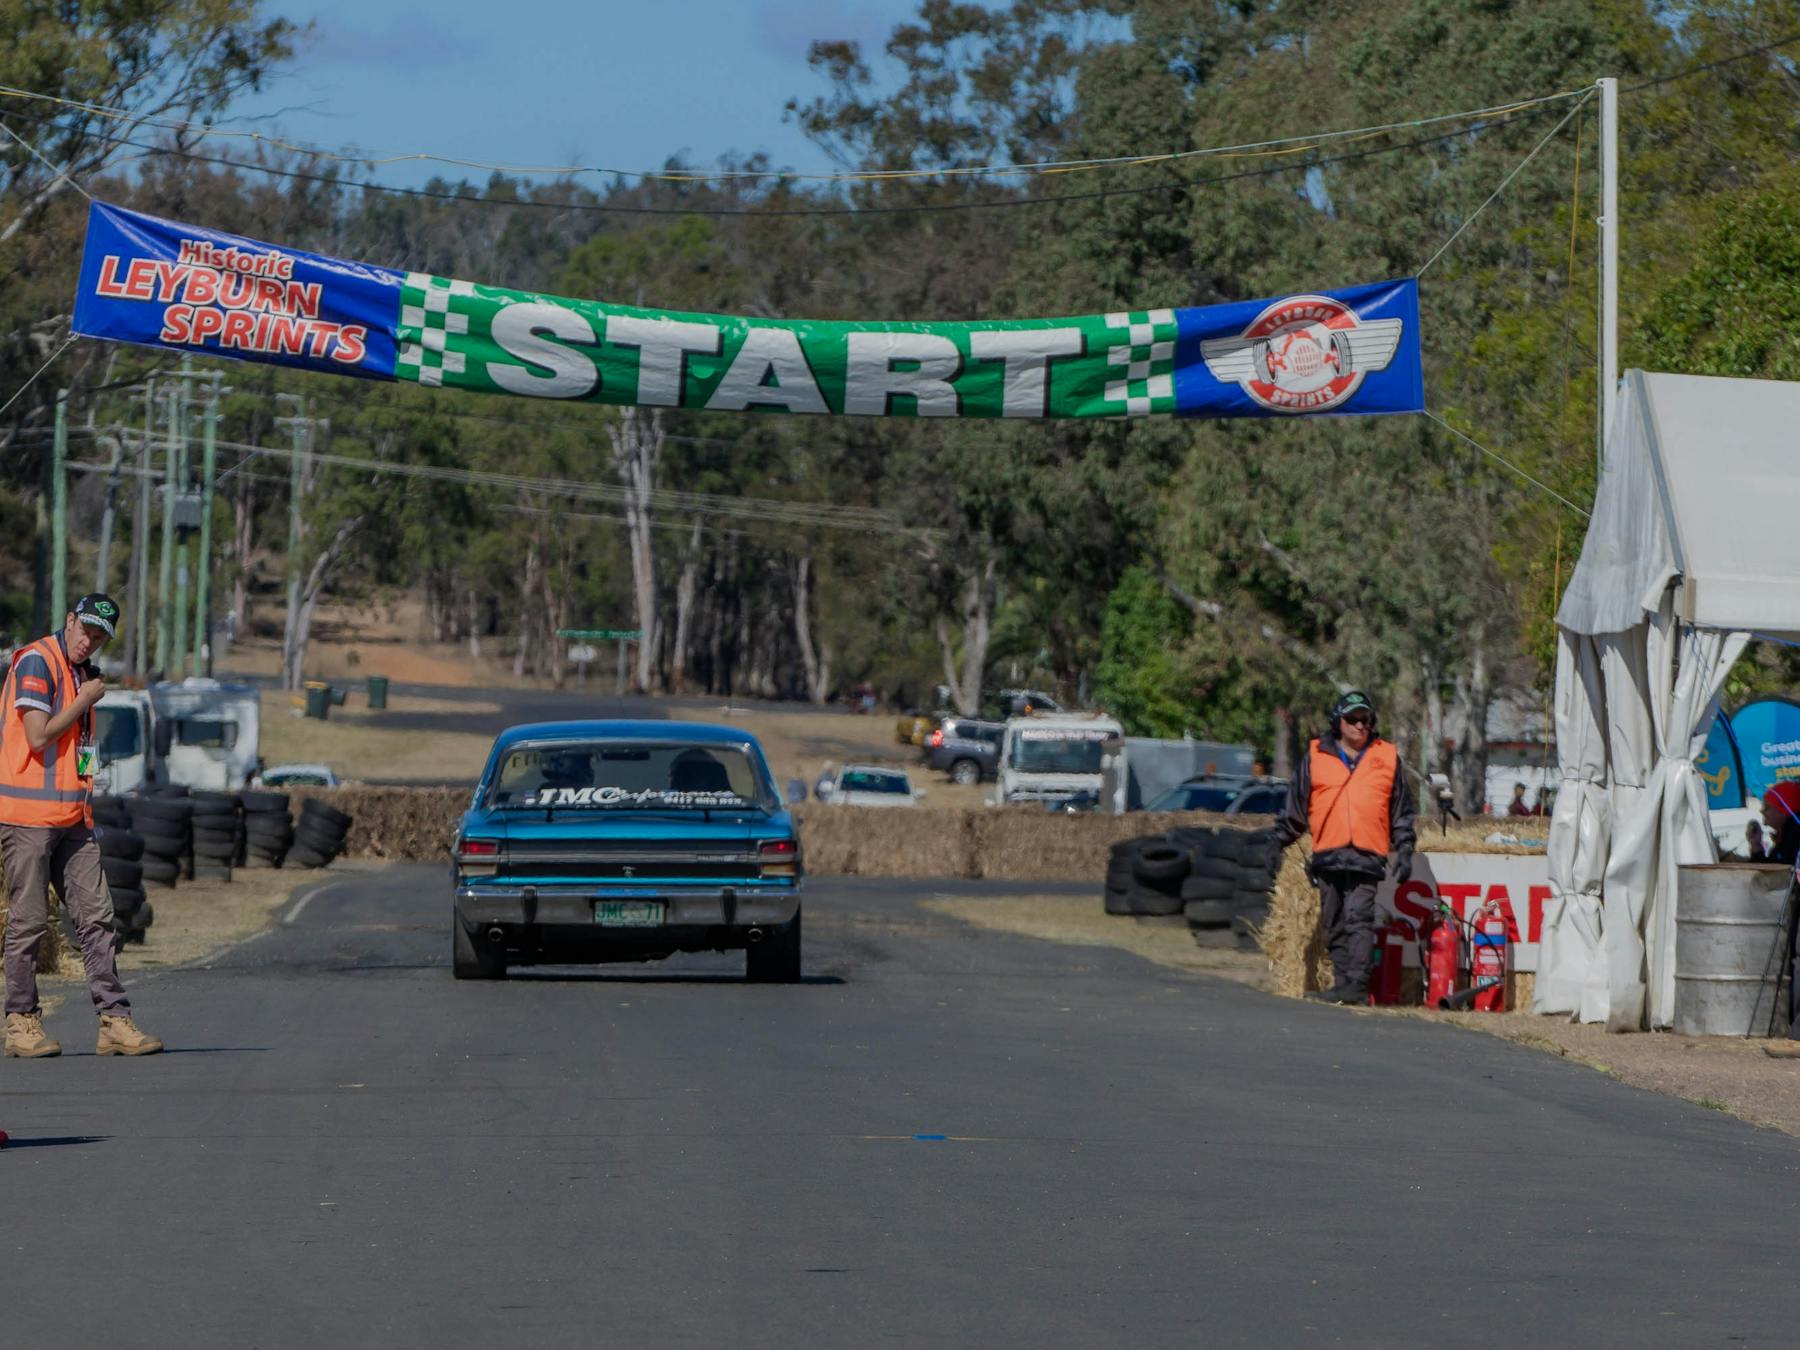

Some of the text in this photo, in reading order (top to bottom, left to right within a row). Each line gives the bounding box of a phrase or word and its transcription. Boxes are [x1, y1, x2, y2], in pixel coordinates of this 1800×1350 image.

[177, 239, 295, 280] Historic
[96, 255, 323, 319] LEYBURN
[159, 303, 367, 364] SPRINTS
[485, 301, 1087, 418] START
[1270, 386, 1335, 407] SPRINTS
[539, 786, 622, 805] JMC
[596, 903, 660, 920] JMC 71
